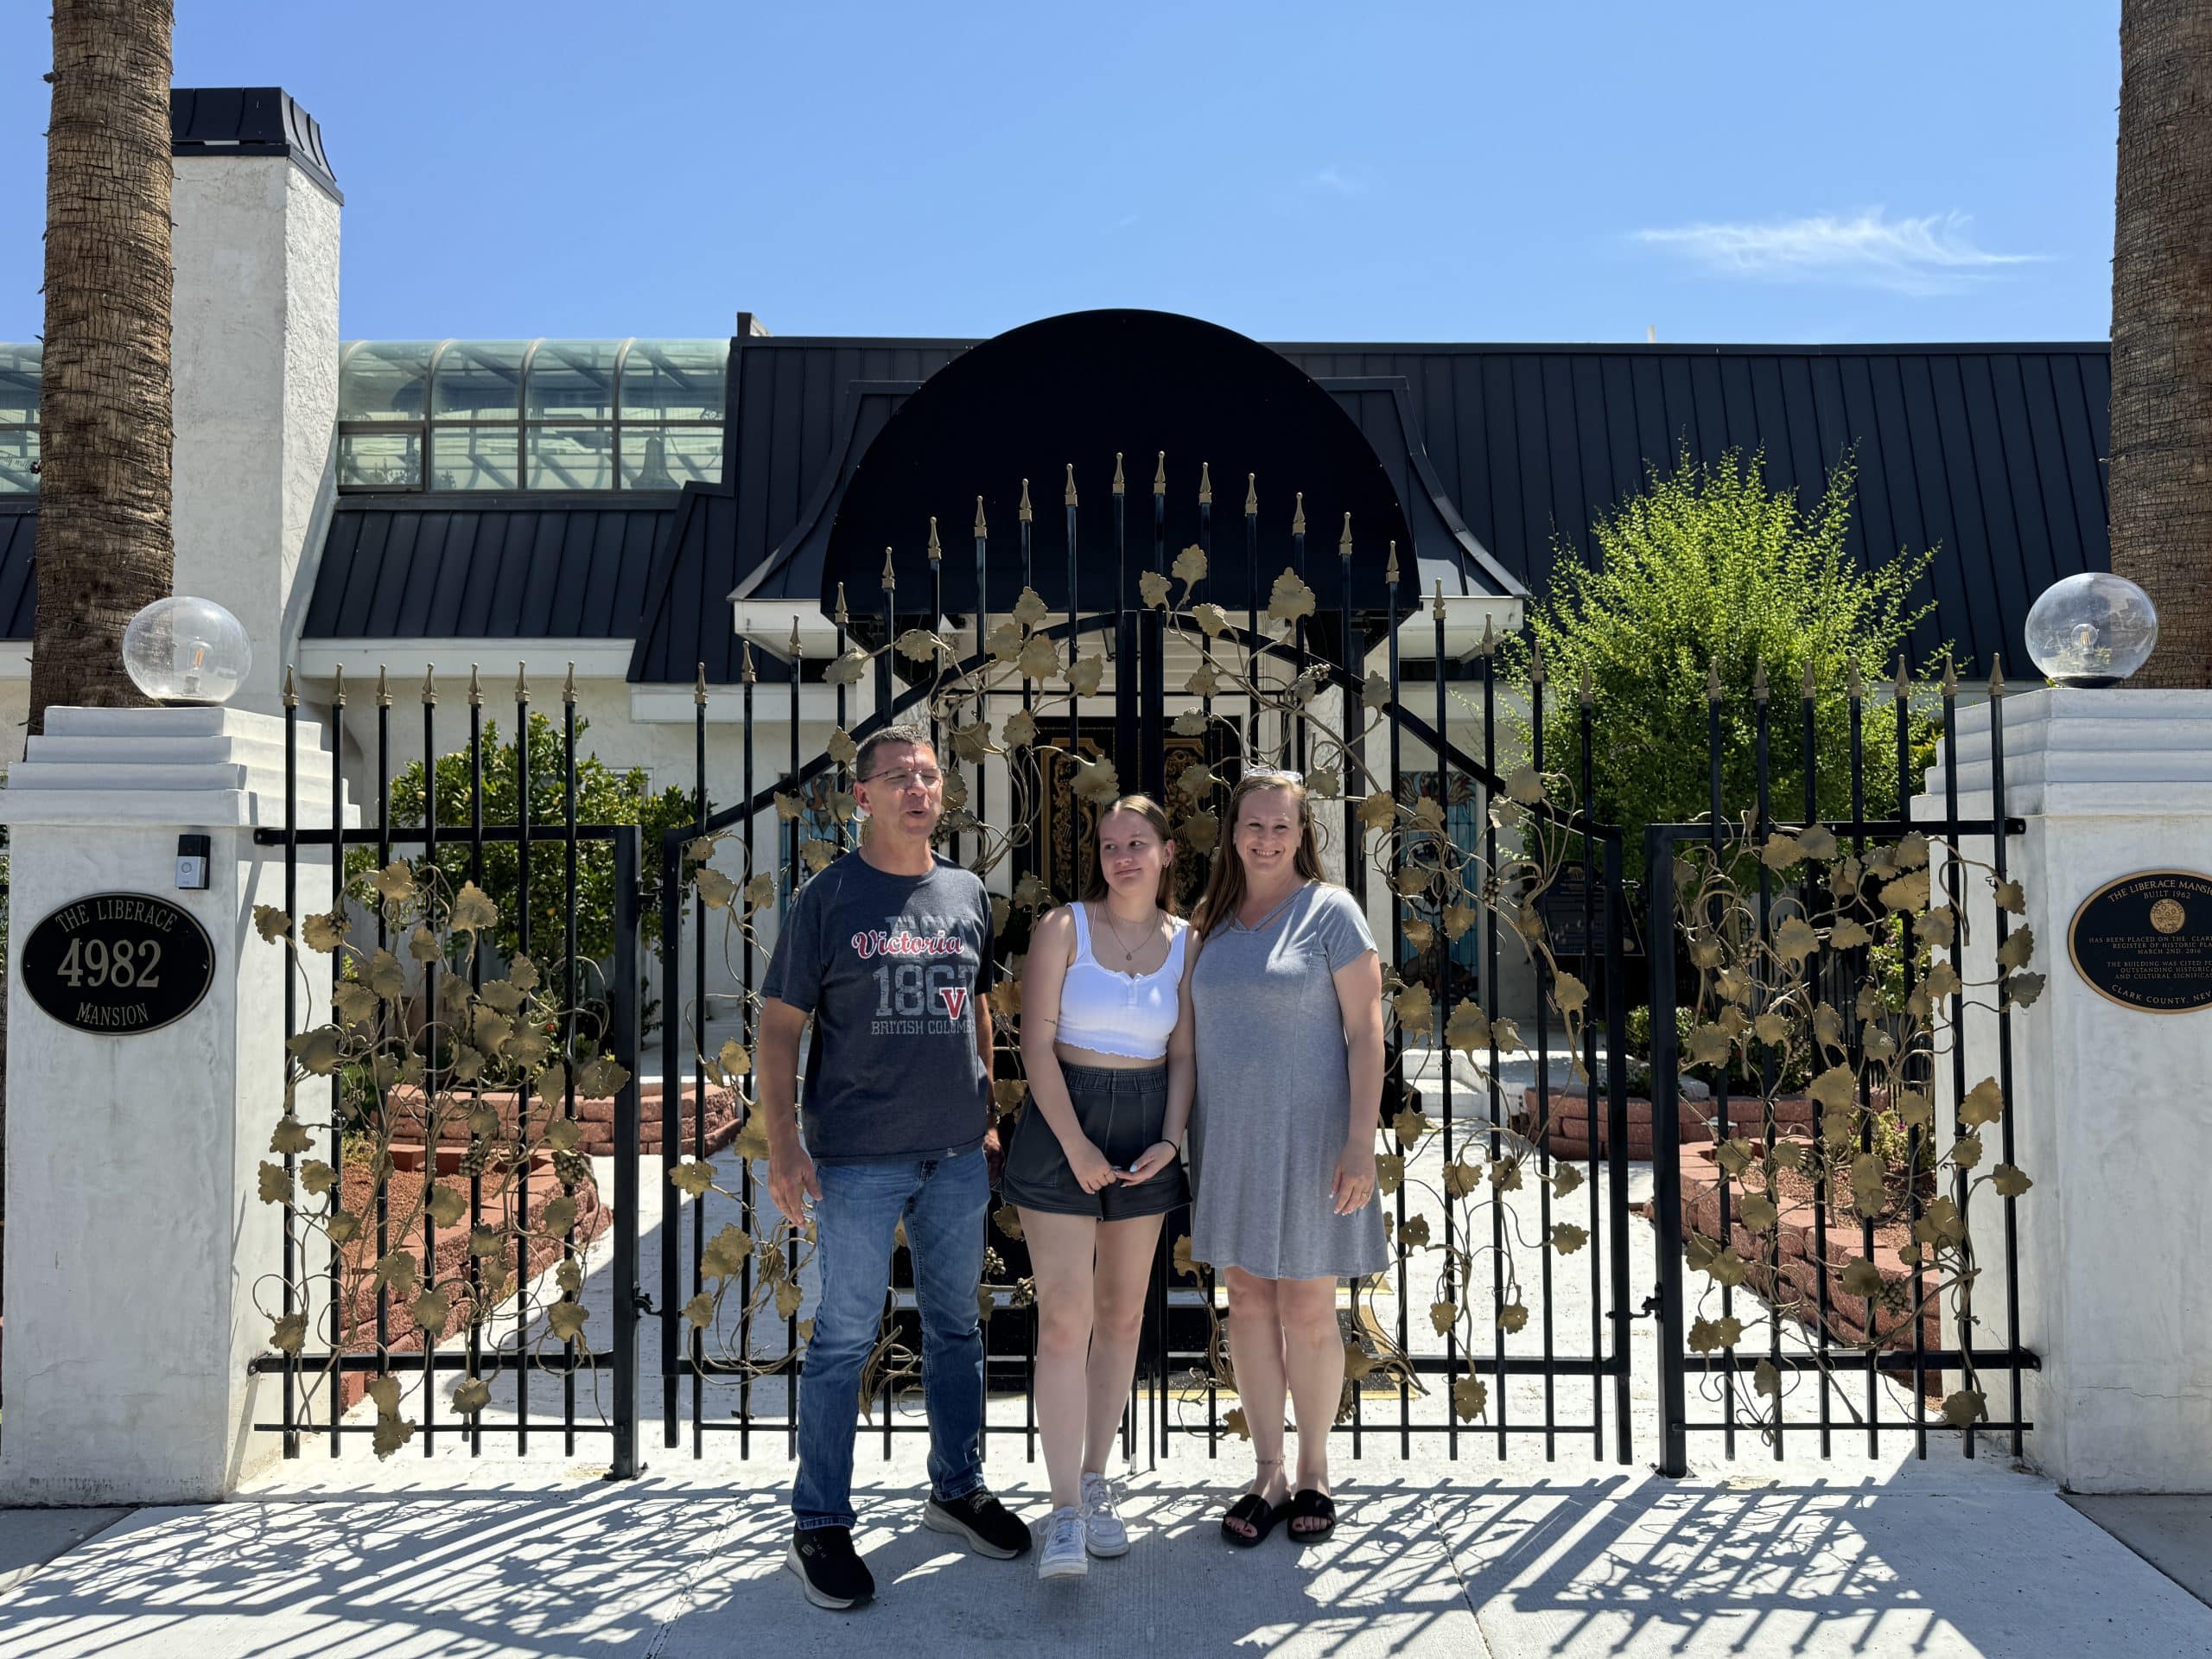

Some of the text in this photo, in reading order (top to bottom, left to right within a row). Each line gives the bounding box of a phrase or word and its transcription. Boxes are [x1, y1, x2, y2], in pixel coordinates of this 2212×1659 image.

[2108, 888, 2128, 902] THE
[2129, 880, 2176, 893] LIBERACE
[2143, 890, 2191, 899] BUILT 1962
[55, 899, 178, 933] THE LIBERACE
[851, 929, 965, 959] Victoria
[57, 938, 162, 988] 4982
[939, 987, 967, 1020] V
[2112, 984, 2142, 1001] CLARK
[76, 1001, 149, 1027] MANSION
[871, 1020, 924, 1035] BRITISH
